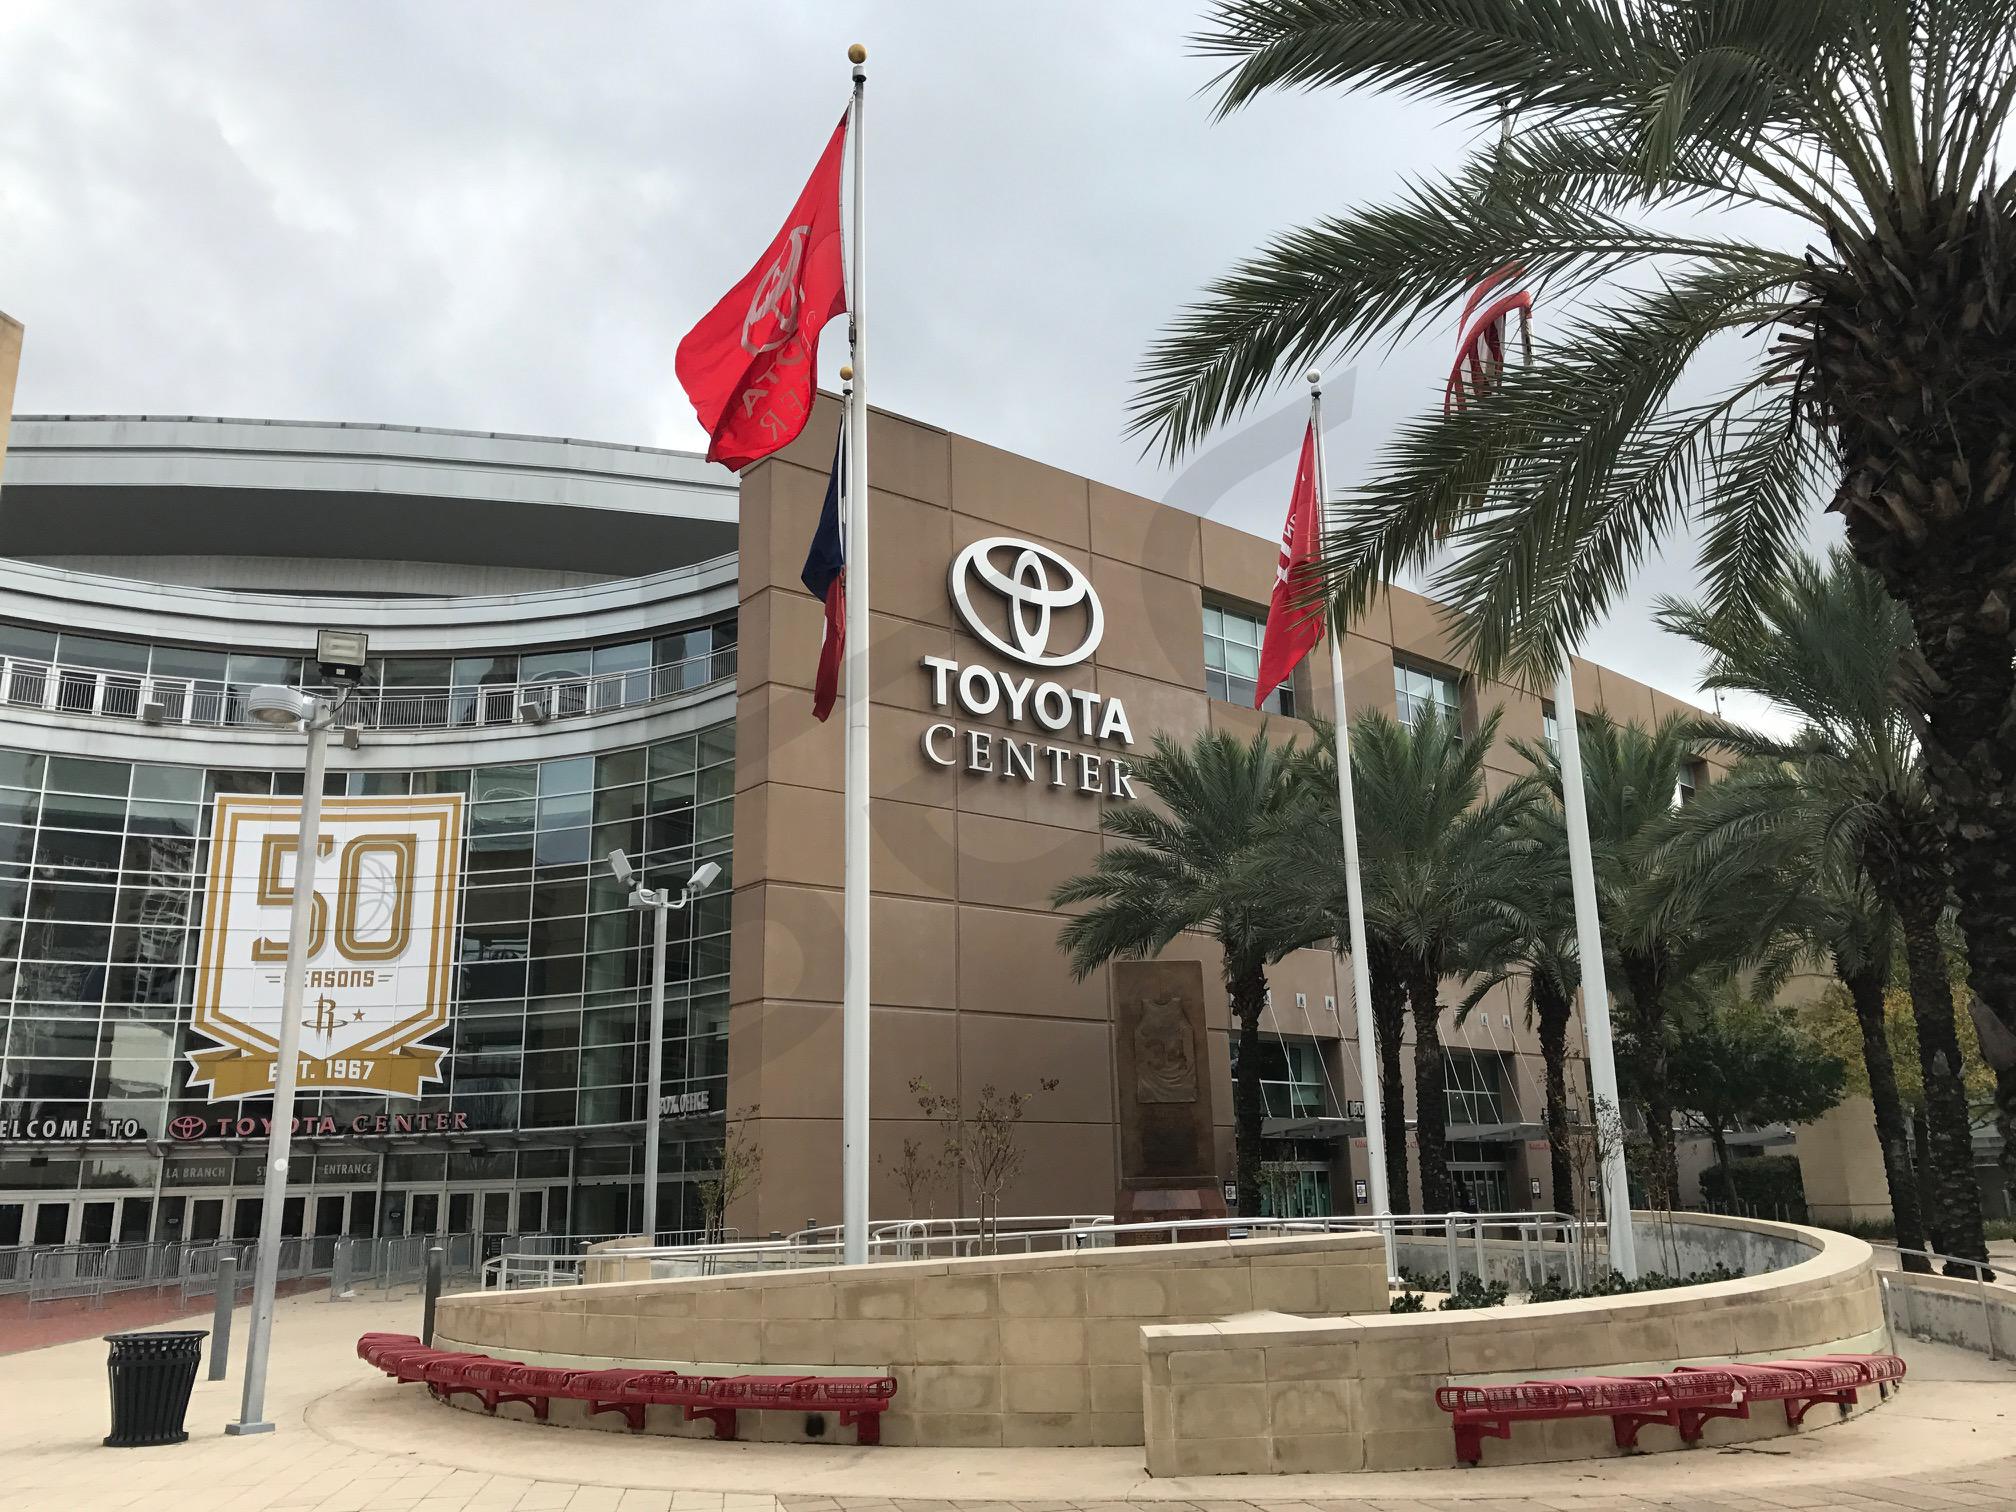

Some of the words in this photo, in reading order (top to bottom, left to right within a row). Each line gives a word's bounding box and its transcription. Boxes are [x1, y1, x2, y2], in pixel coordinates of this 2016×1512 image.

[920, 655, 1134, 744] TOYOTA
[920, 724, 1137, 799] CENTER
[251, 834, 417, 962] 50
[304, 970, 375, 988] ASONS
[267, 1060, 316, 1082] ET.
[326, 1059, 375, 1080] 1967
[680, 1090, 709, 1112] OFFICE
[0, 1119, 92, 1138] ELCOME
[109, 1119, 140, 1138] TO
[352, 1112, 469, 1133] CENTER
[166, 1167, 178, 1179] LA
[183, 1166, 226, 1178] BRANCH
[323, 1163, 372, 1175] ENTRANCE
